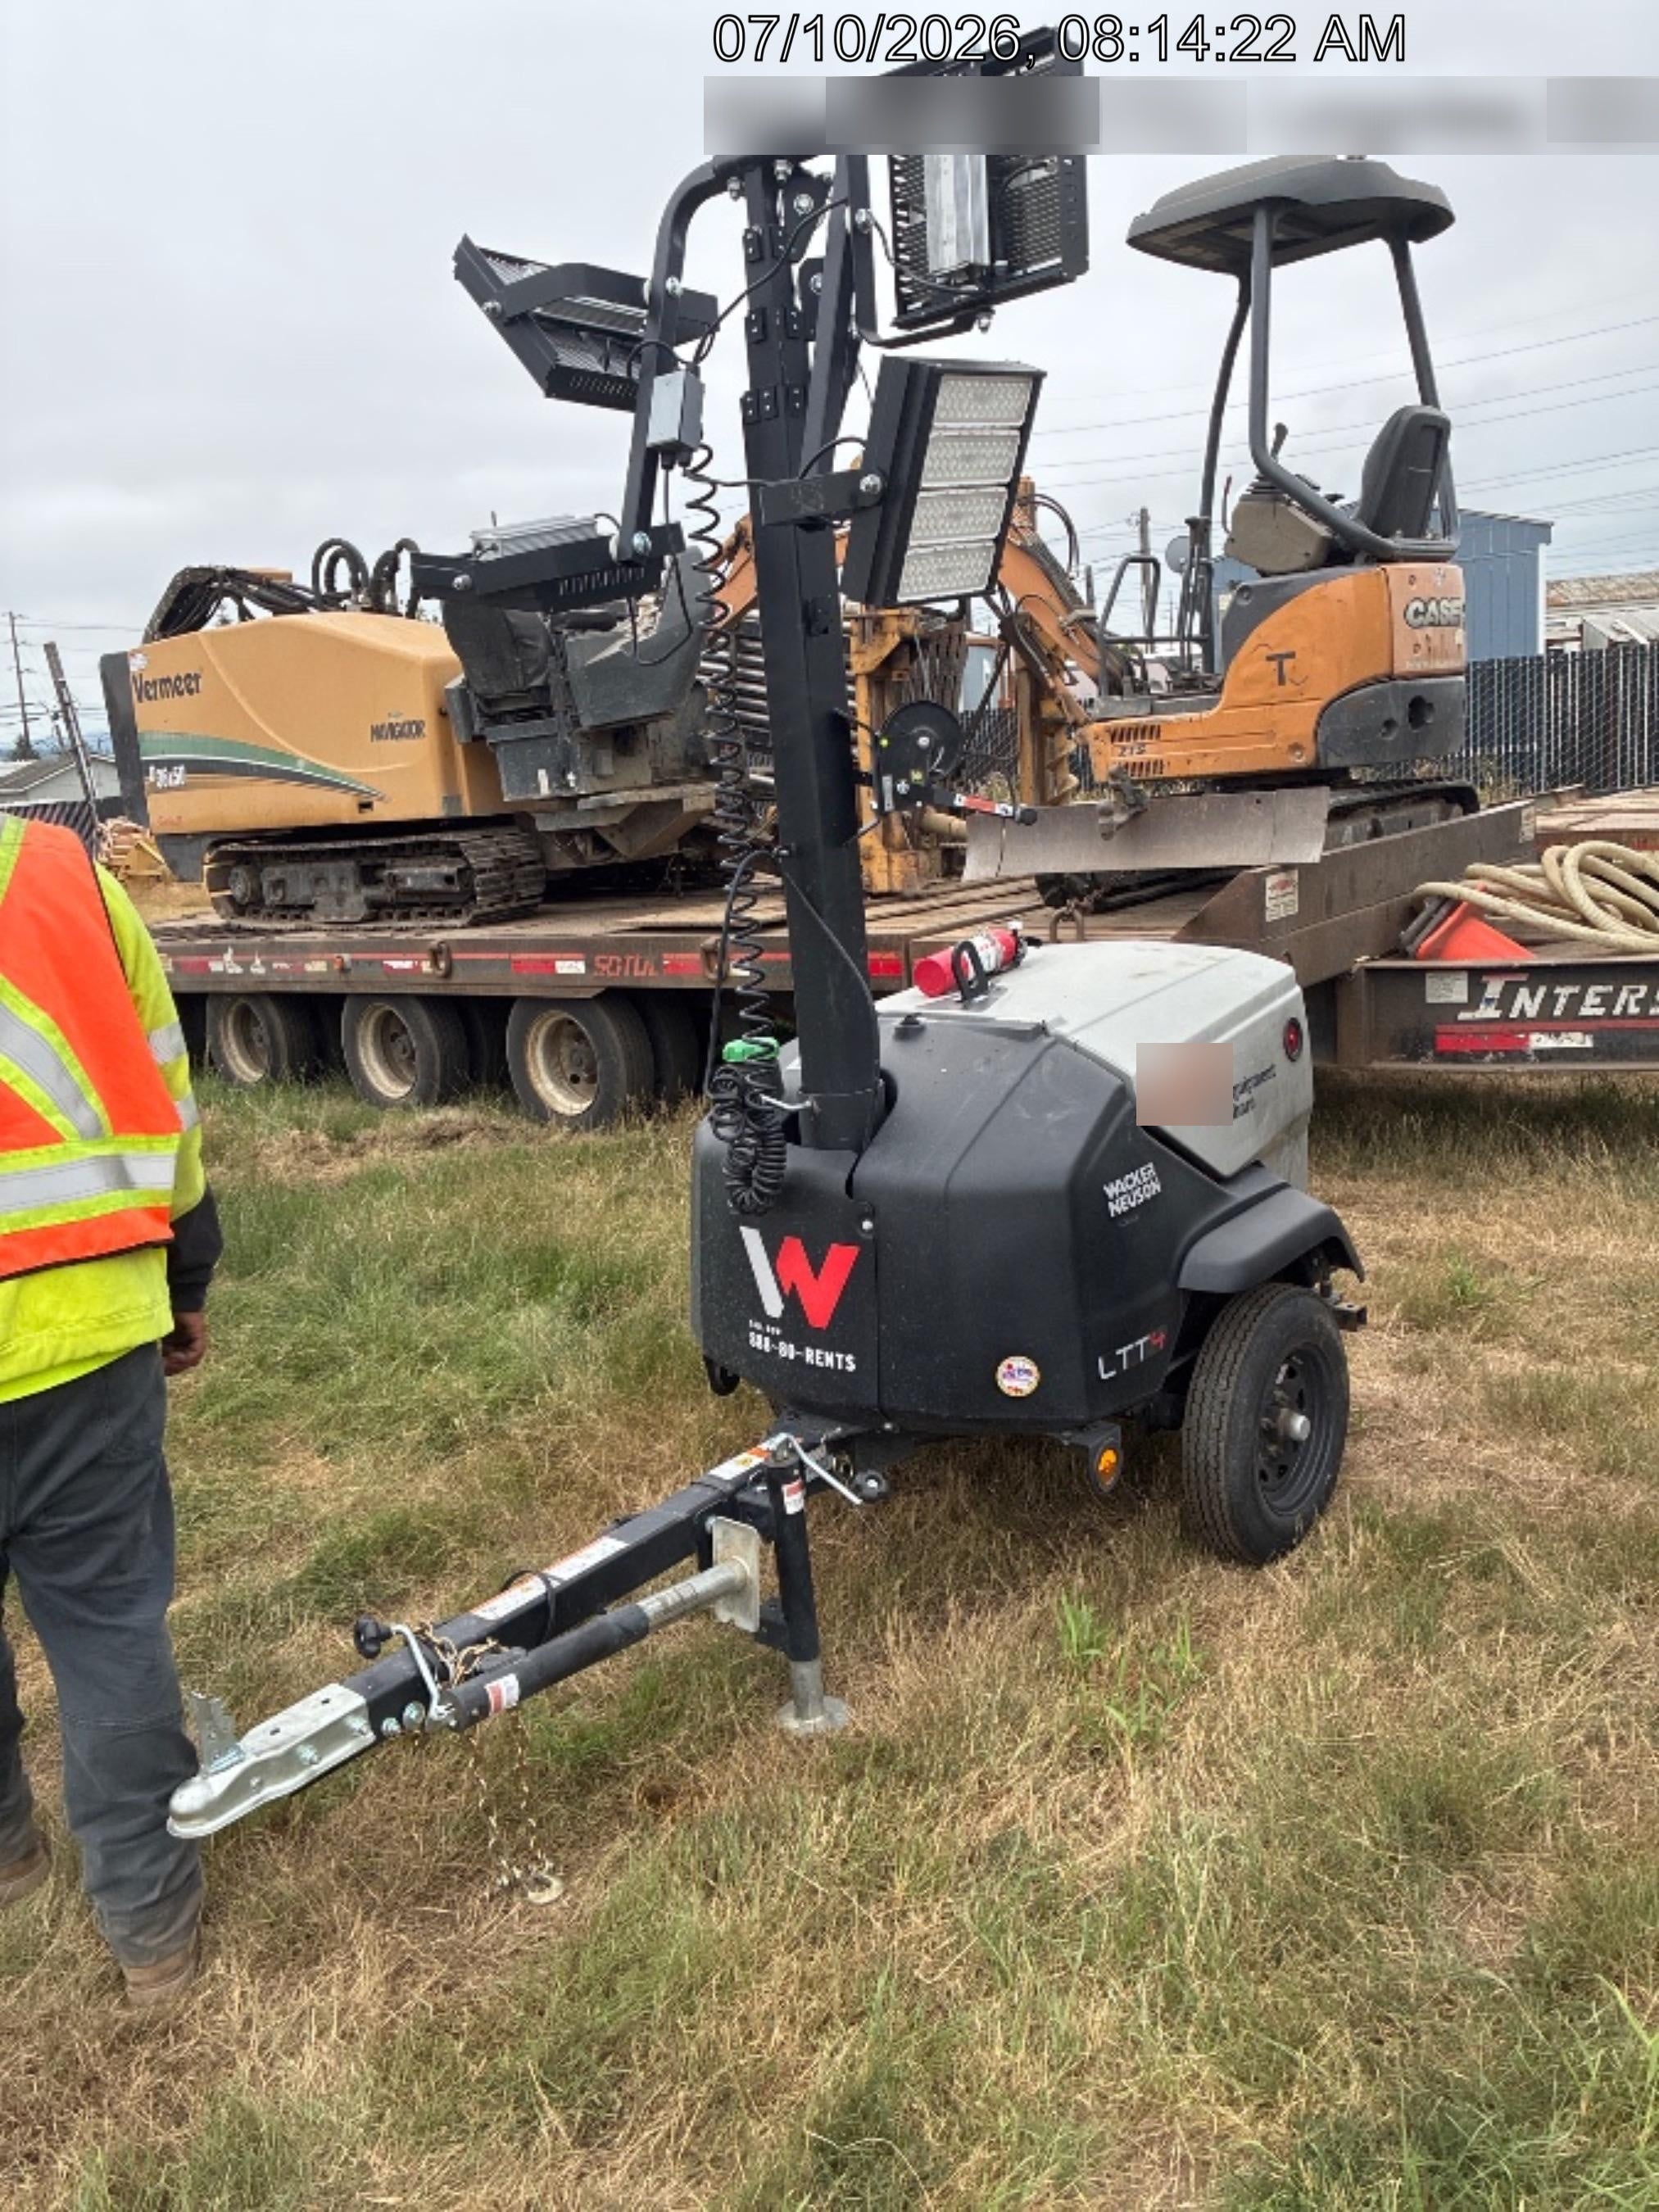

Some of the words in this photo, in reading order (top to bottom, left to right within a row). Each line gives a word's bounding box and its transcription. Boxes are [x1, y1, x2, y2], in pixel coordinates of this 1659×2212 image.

[1403, 596, 1465, 628] CASE
[131, 673, 202, 704] Vermeer
[1102, 1161, 1157, 1200] WACKER
[1108, 1176, 1162, 1218] NEUSON
